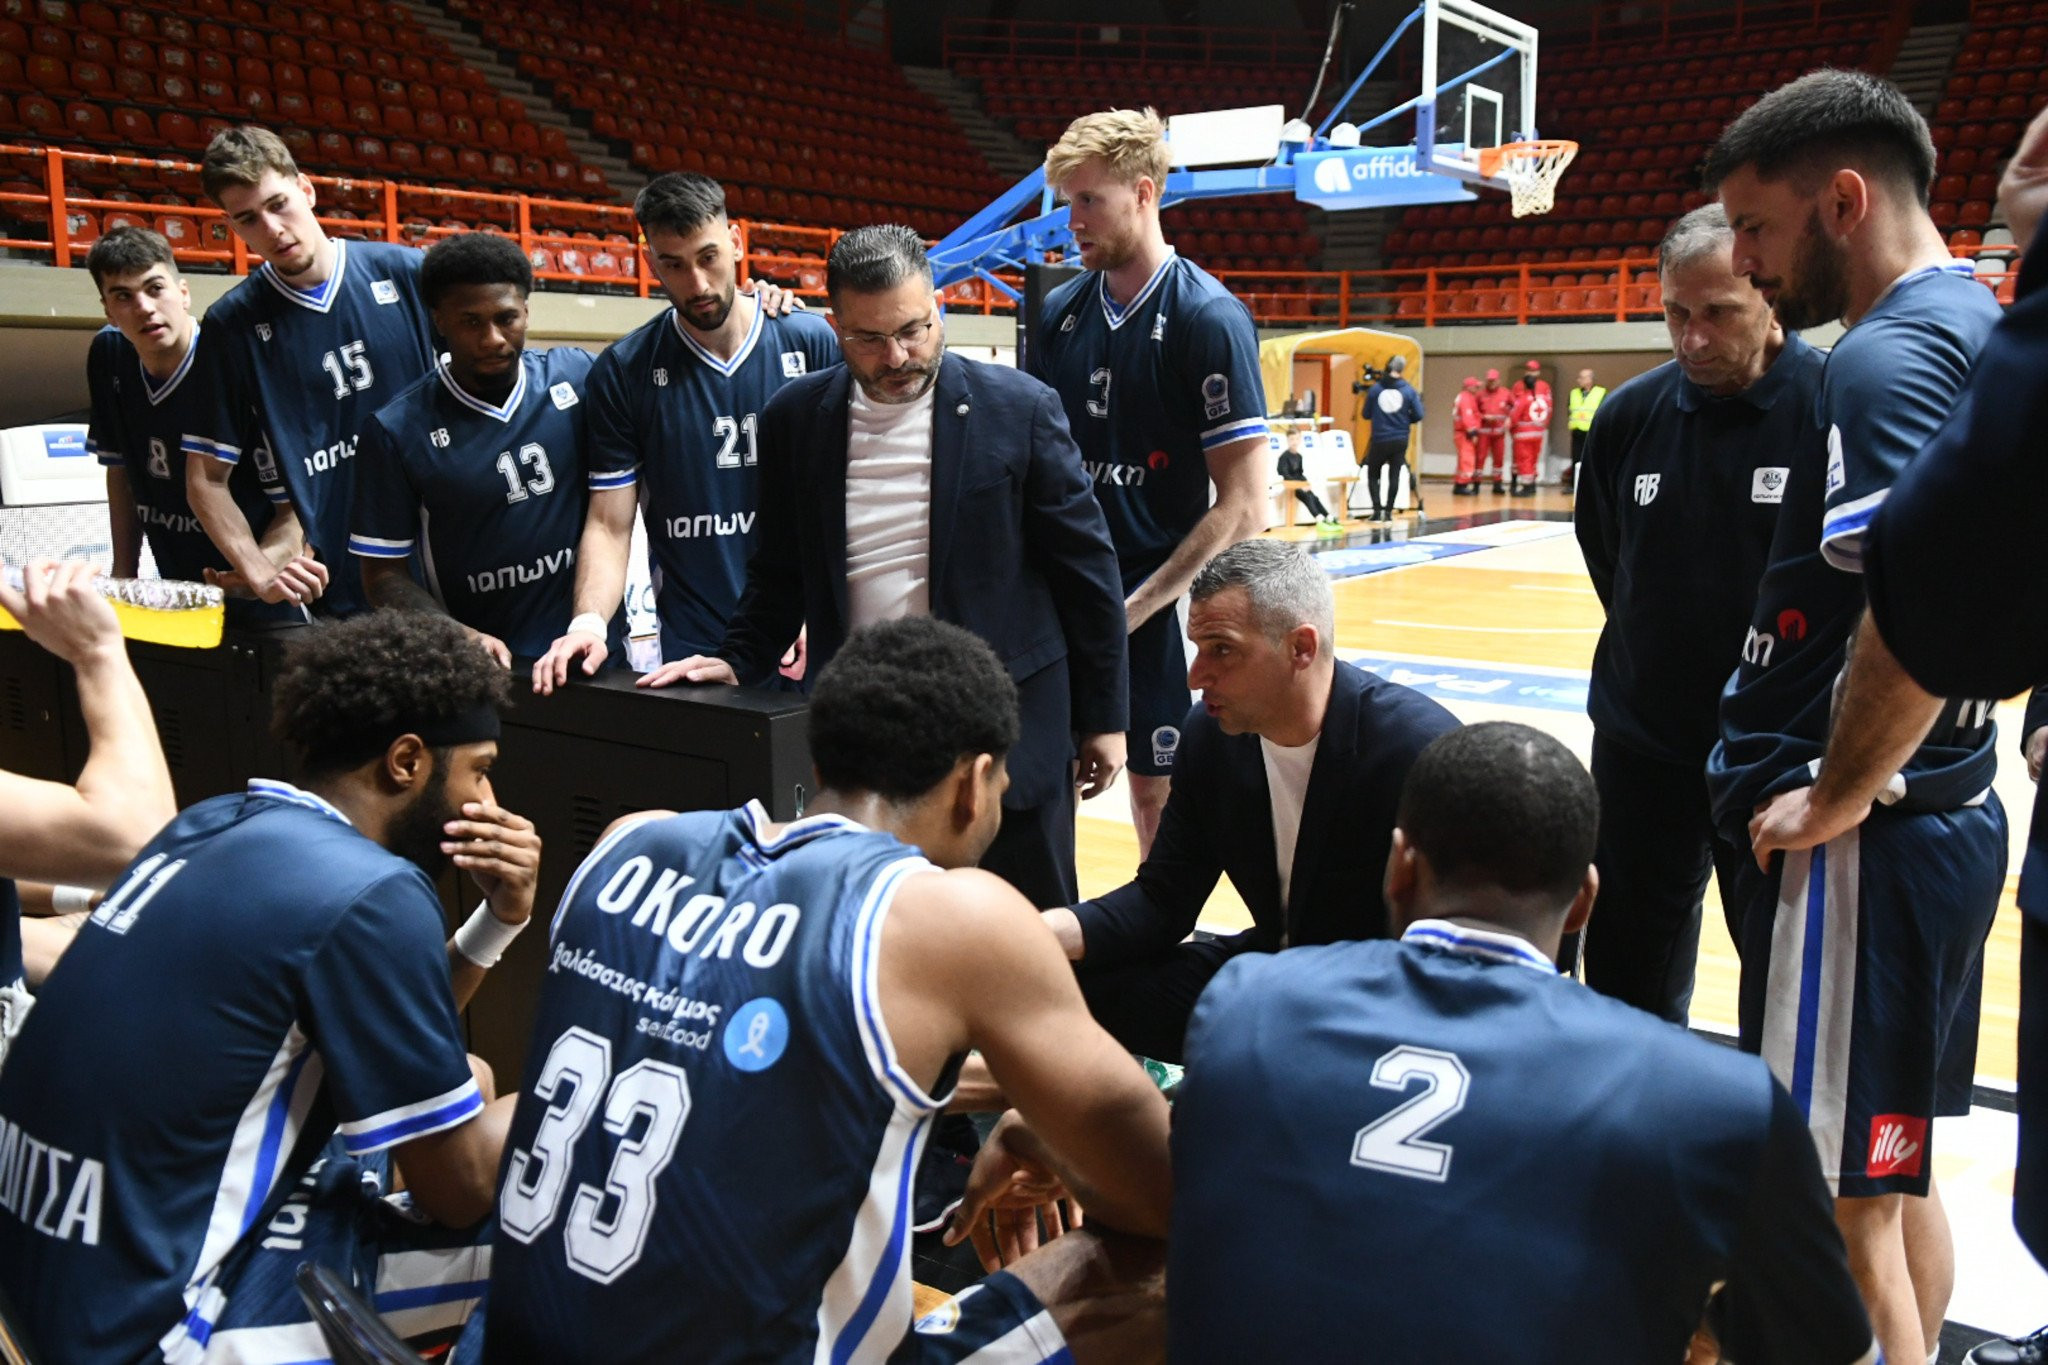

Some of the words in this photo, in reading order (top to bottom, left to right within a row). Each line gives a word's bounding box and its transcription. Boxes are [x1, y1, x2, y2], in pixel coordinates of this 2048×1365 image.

[1352, 154, 1434, 180] affid
[322, 339, 375, 400] 15
[1085, 367, 1112, 419] 3
[147, 437, 171, 480] 8
[712, 413, 758, 468] 21
[496, 441, 555, 504] 13
[90, 852, 187, 935] 11
[597, 855, 800, 968] OKORO
[1349, 1044, 1471, 1183] 2
[500, 1026, 692, 1285] 33
[1871, 1122, 1918, 1169] illy
[0, 1114, 103, 1246] ΔΙΤΣΑ
